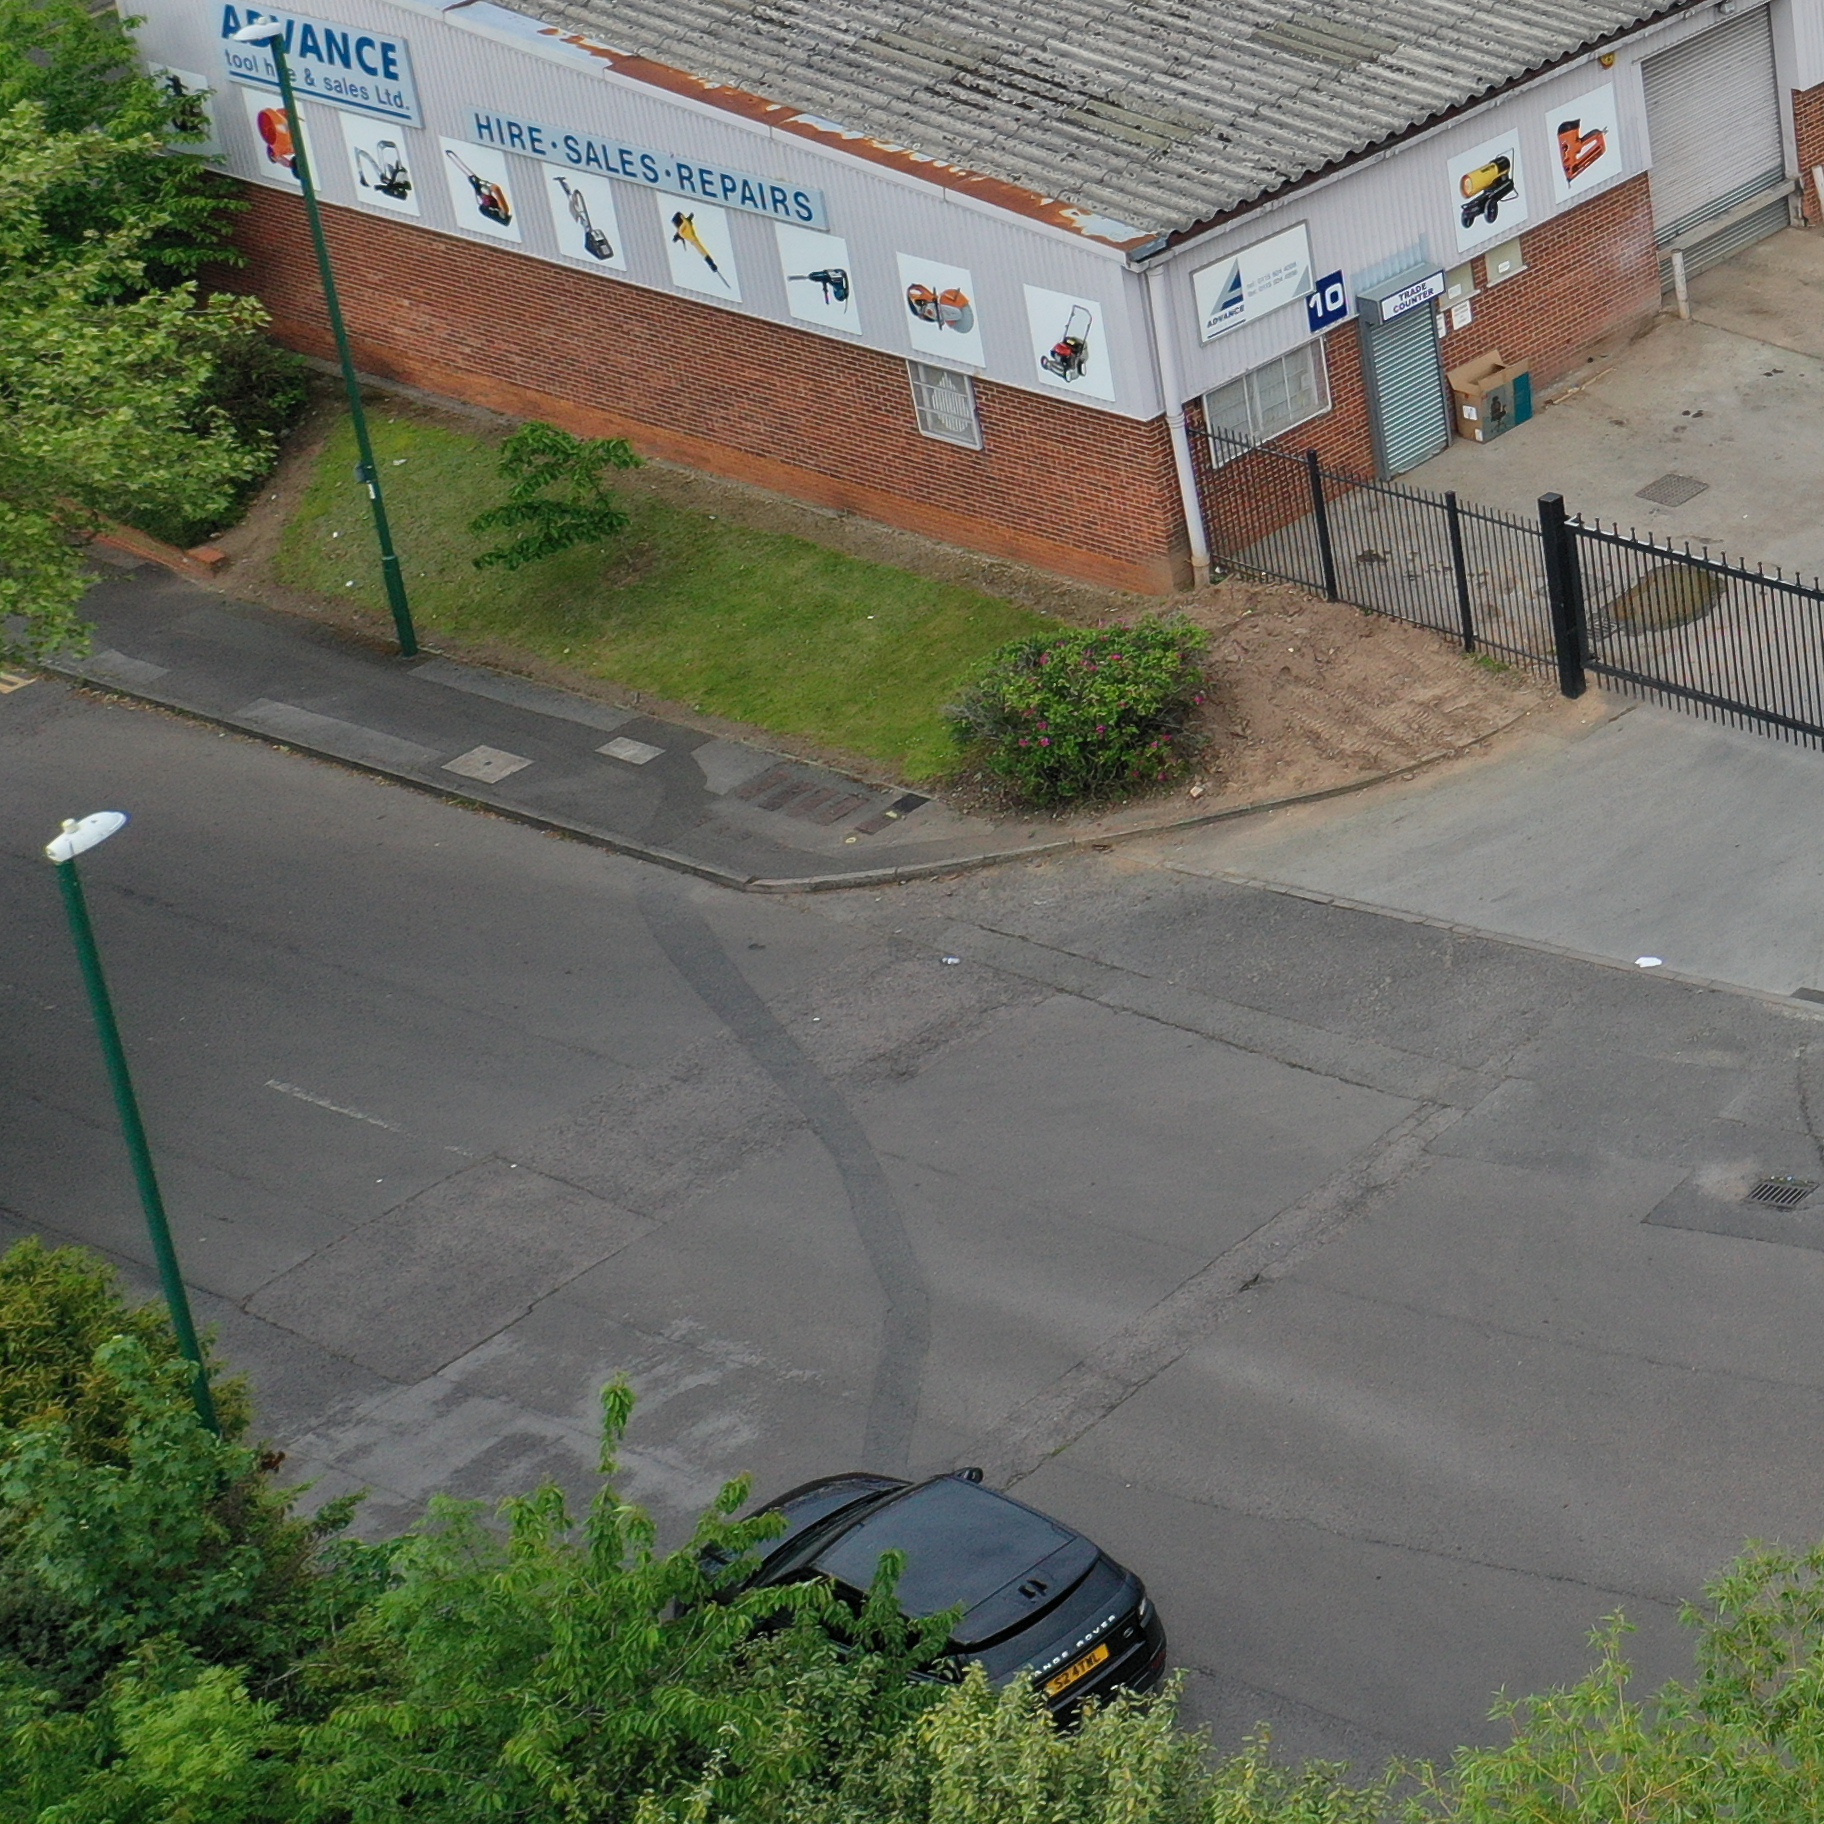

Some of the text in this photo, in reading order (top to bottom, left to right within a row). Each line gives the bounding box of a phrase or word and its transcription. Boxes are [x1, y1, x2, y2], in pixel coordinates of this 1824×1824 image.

[225, 49, 259, 72] tool
[304, 68, 316, 86] &
[324, 76, 370, 100] sales
[375, 86, 410, 110] Ltd.
[676, 162, 814, 222] REPAIRS
[1309, 282, 1344, 318] 10
[1393, 287, 1434, 315] COUNTER
[1398, 282, 1427, 302] TRADE
[1207, 305, 1245, 329] ADVANCE
[1028, 1615, 1115, 1680] ANGE ROVER
